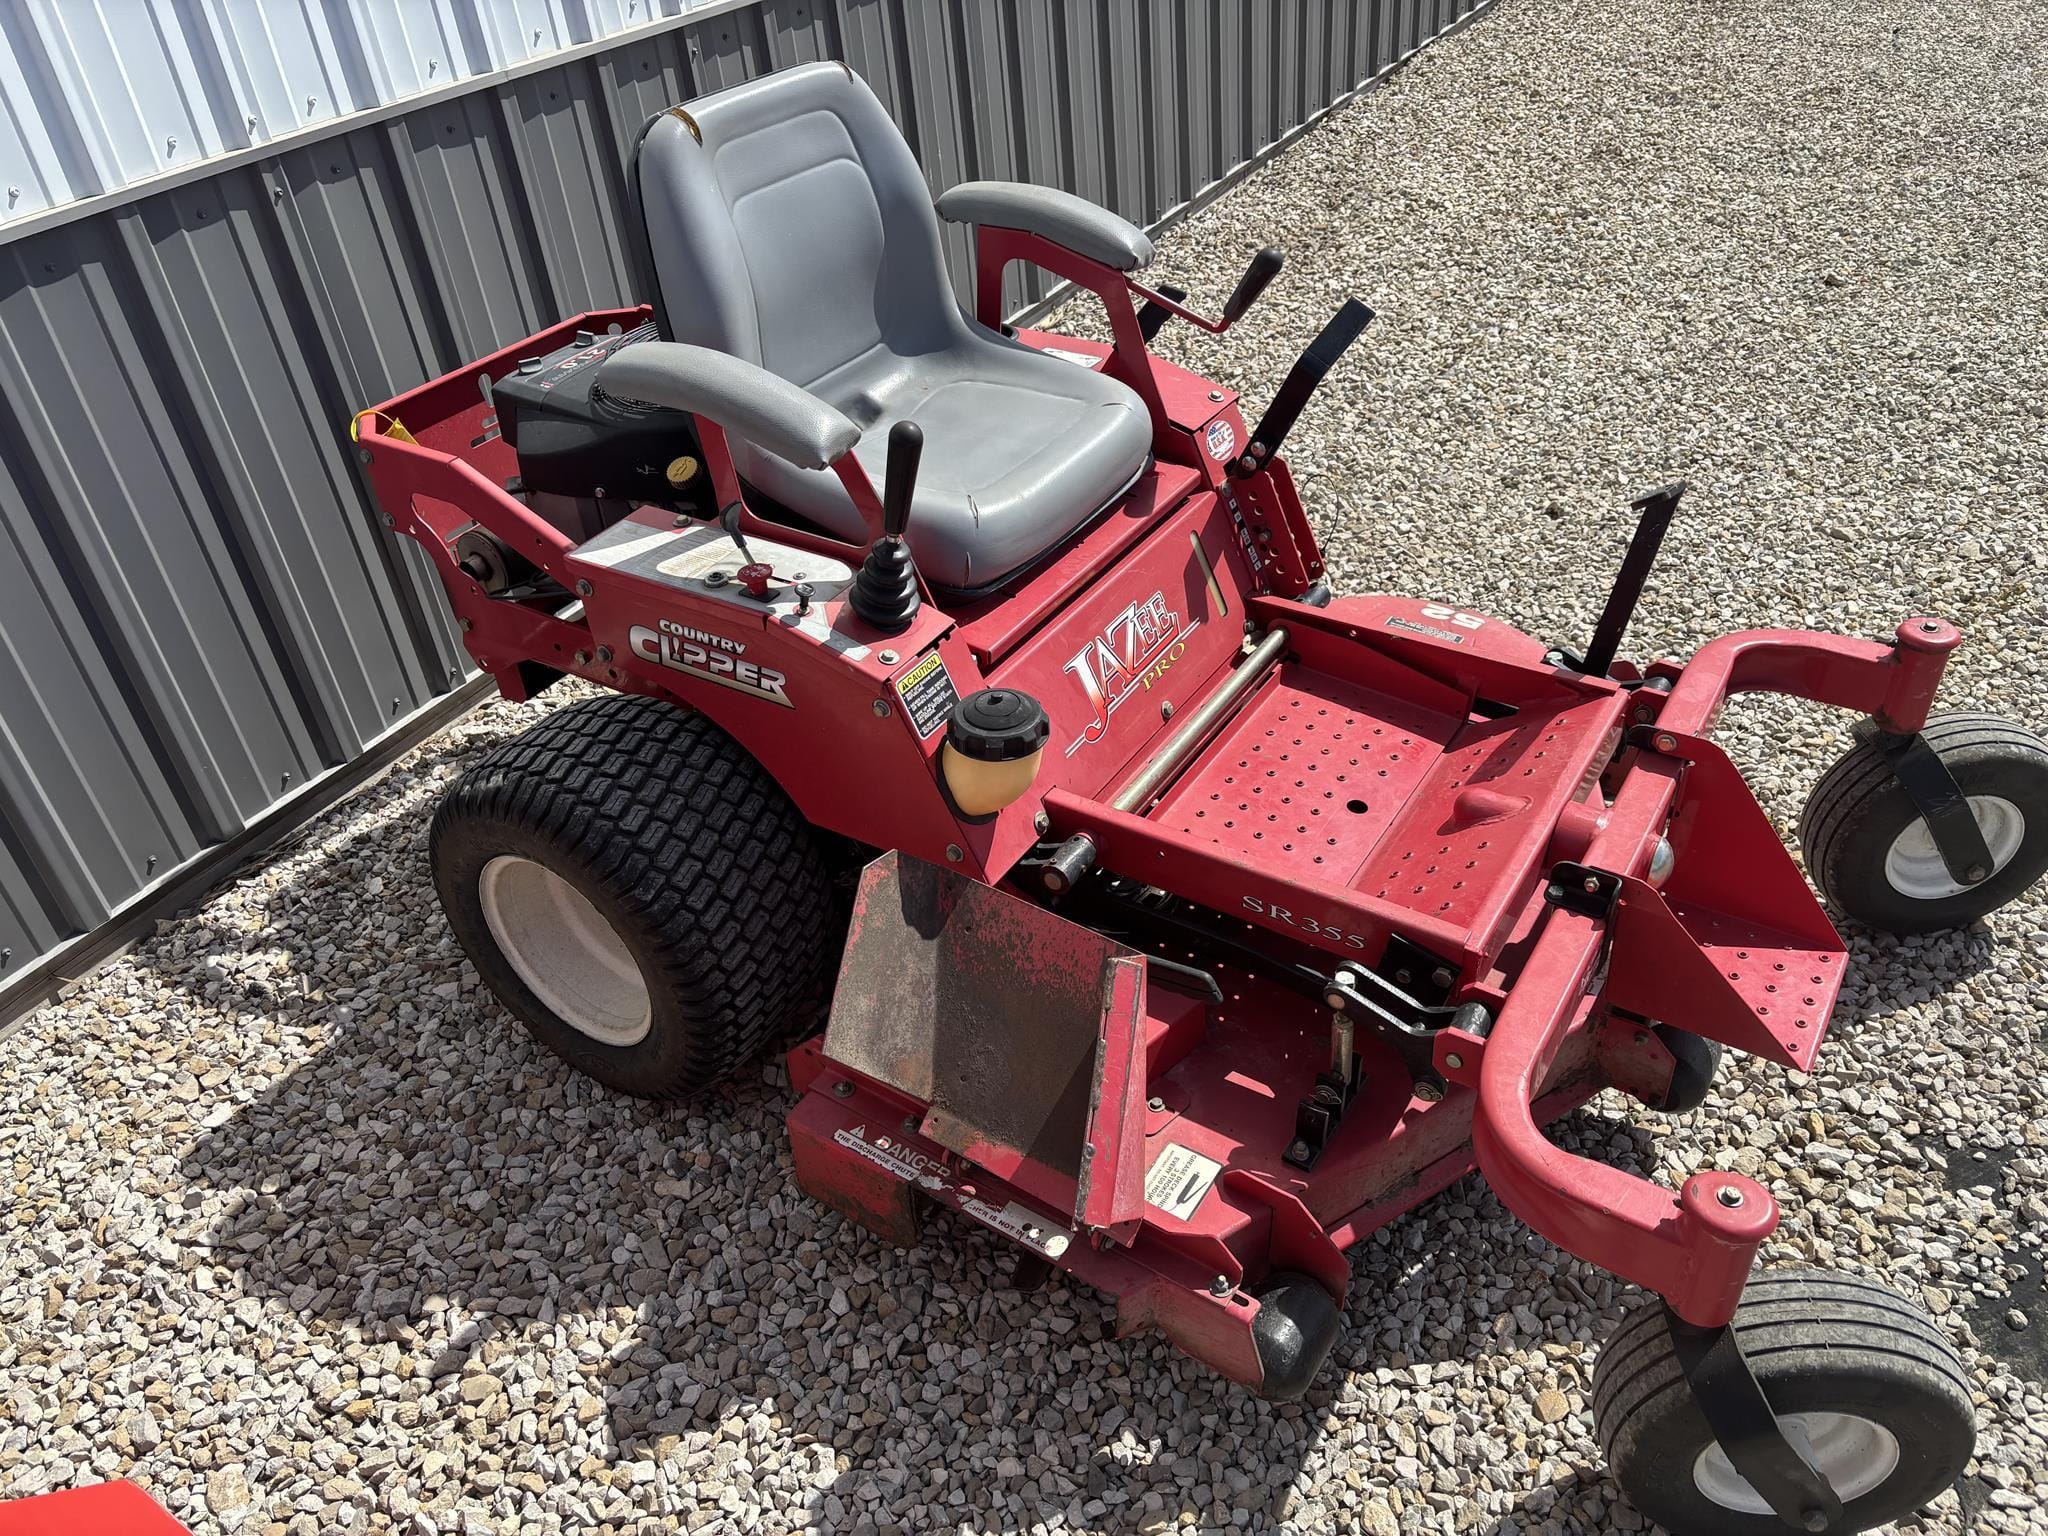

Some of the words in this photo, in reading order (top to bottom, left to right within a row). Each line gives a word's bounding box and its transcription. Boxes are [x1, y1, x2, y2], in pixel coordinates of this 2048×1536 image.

[659, 618, 747, 655] COUNTRY
[1420, 603, 1486, 630] 52
[629, 624, 796, 710] CLIPPER
[906, 656, 939, 687] CAUTION
[1063, 590, 1182, 744] JAZEE
[1141, 642, 1186, 692] PRO
[1242, 895, 1366, 949] SR355
[837, 1133, 850, 1144] THE
[851, 1141, 891, 1166] DISCHARGE
[891, 1162, 916, 1178] CHUTE
[989, 1213, 998, 1222] IS
[998, 1219, 1016, 1233] NOT
[1015, 1227, 1025, 1237] IN
[1168, 1175, 1183, 1192] DECK
[1182, 1155, 1197, 1176] GREASE
